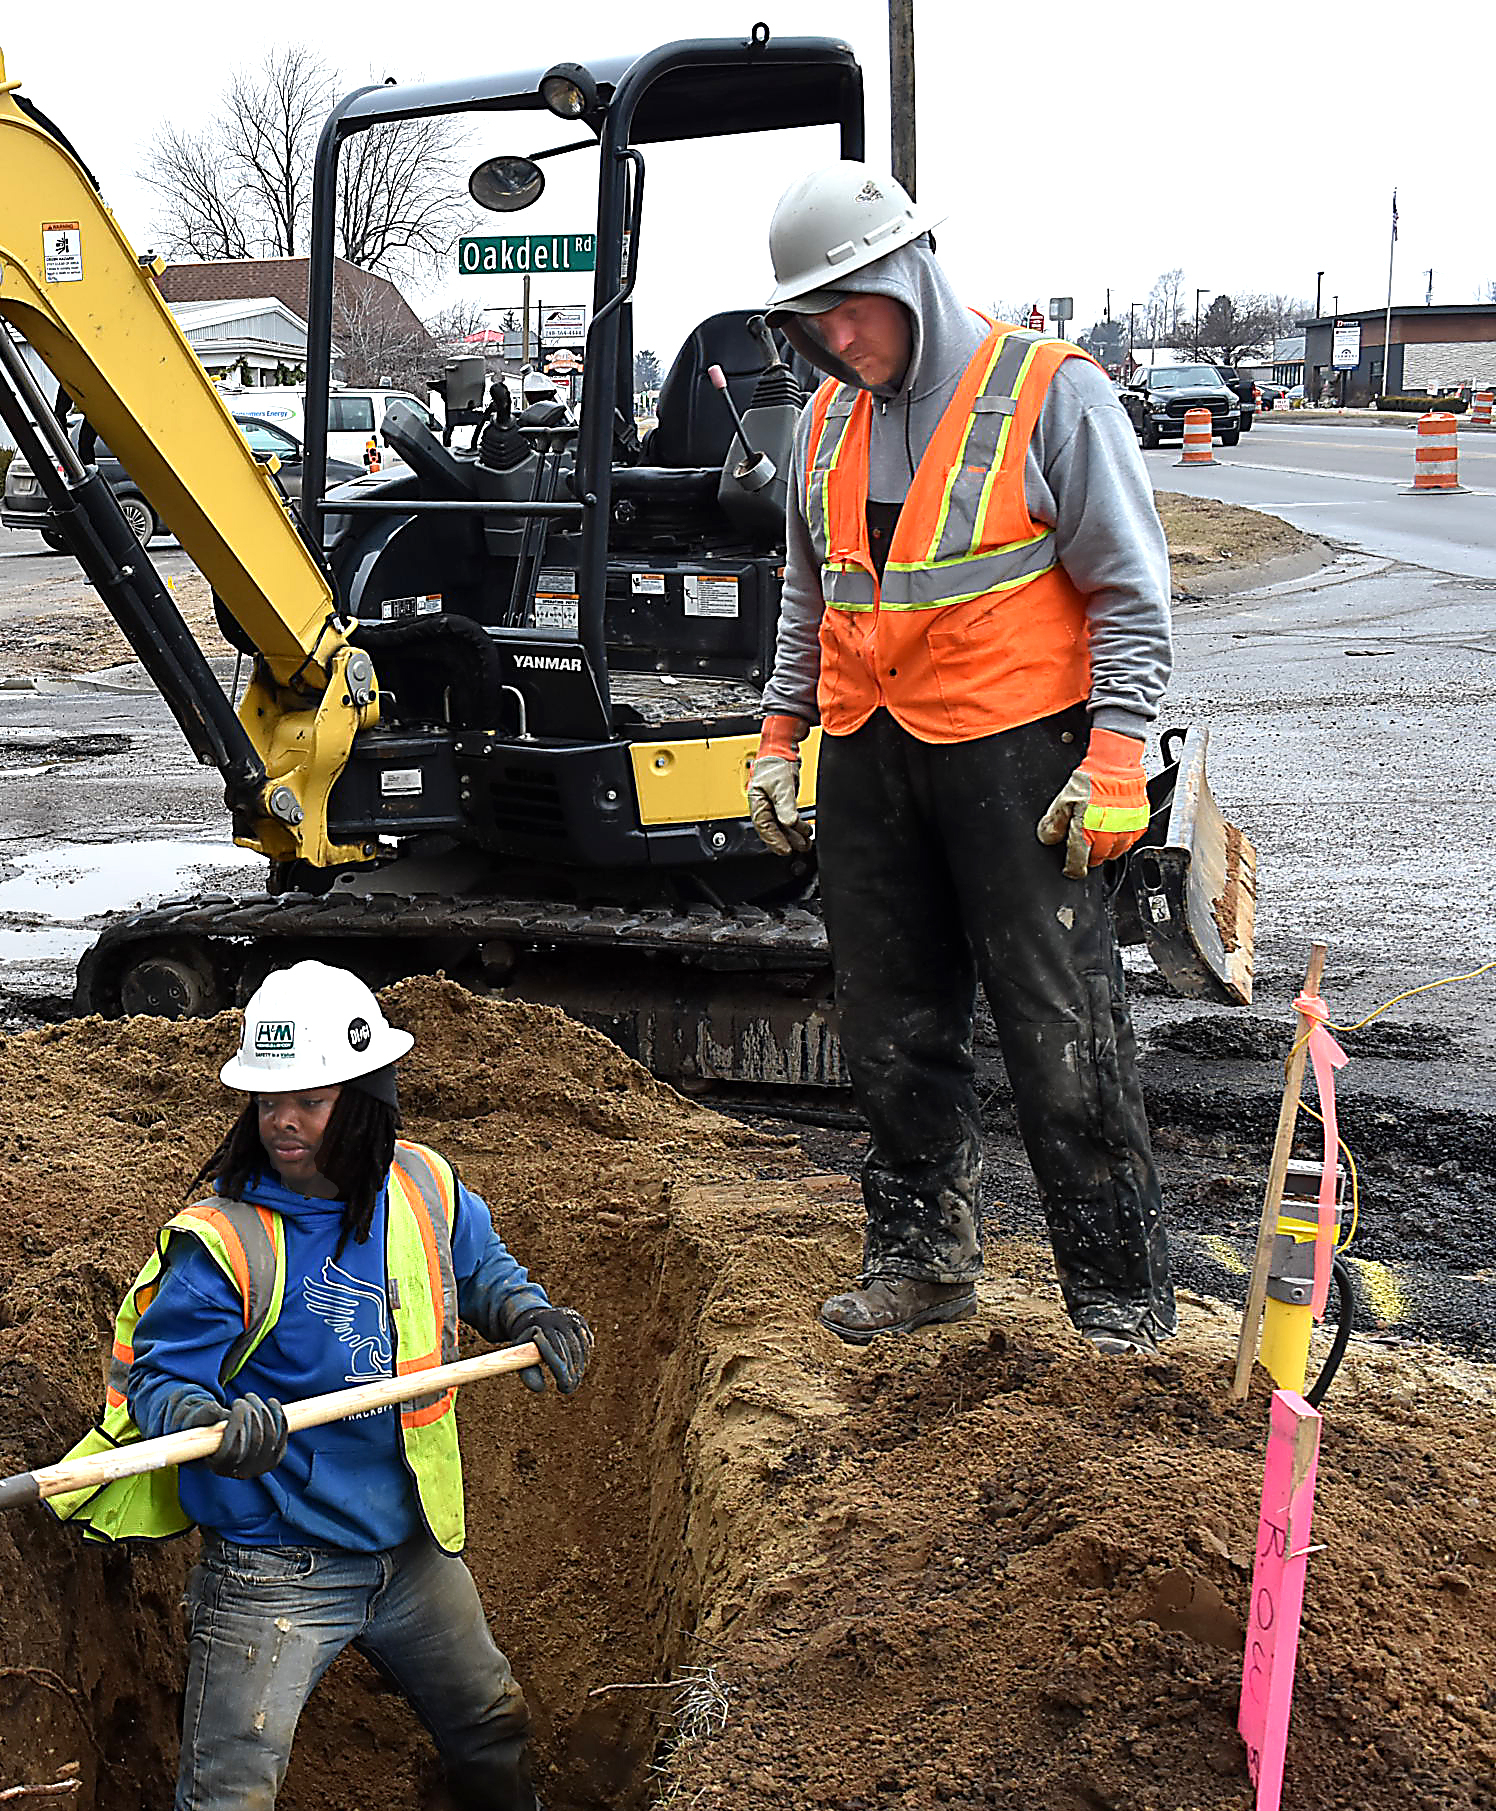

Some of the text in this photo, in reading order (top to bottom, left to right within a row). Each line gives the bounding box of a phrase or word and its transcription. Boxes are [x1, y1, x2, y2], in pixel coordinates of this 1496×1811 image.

[463, 235, 592, 271] Oakdell Rd
[513, 654, 582, 672] YANMAR
